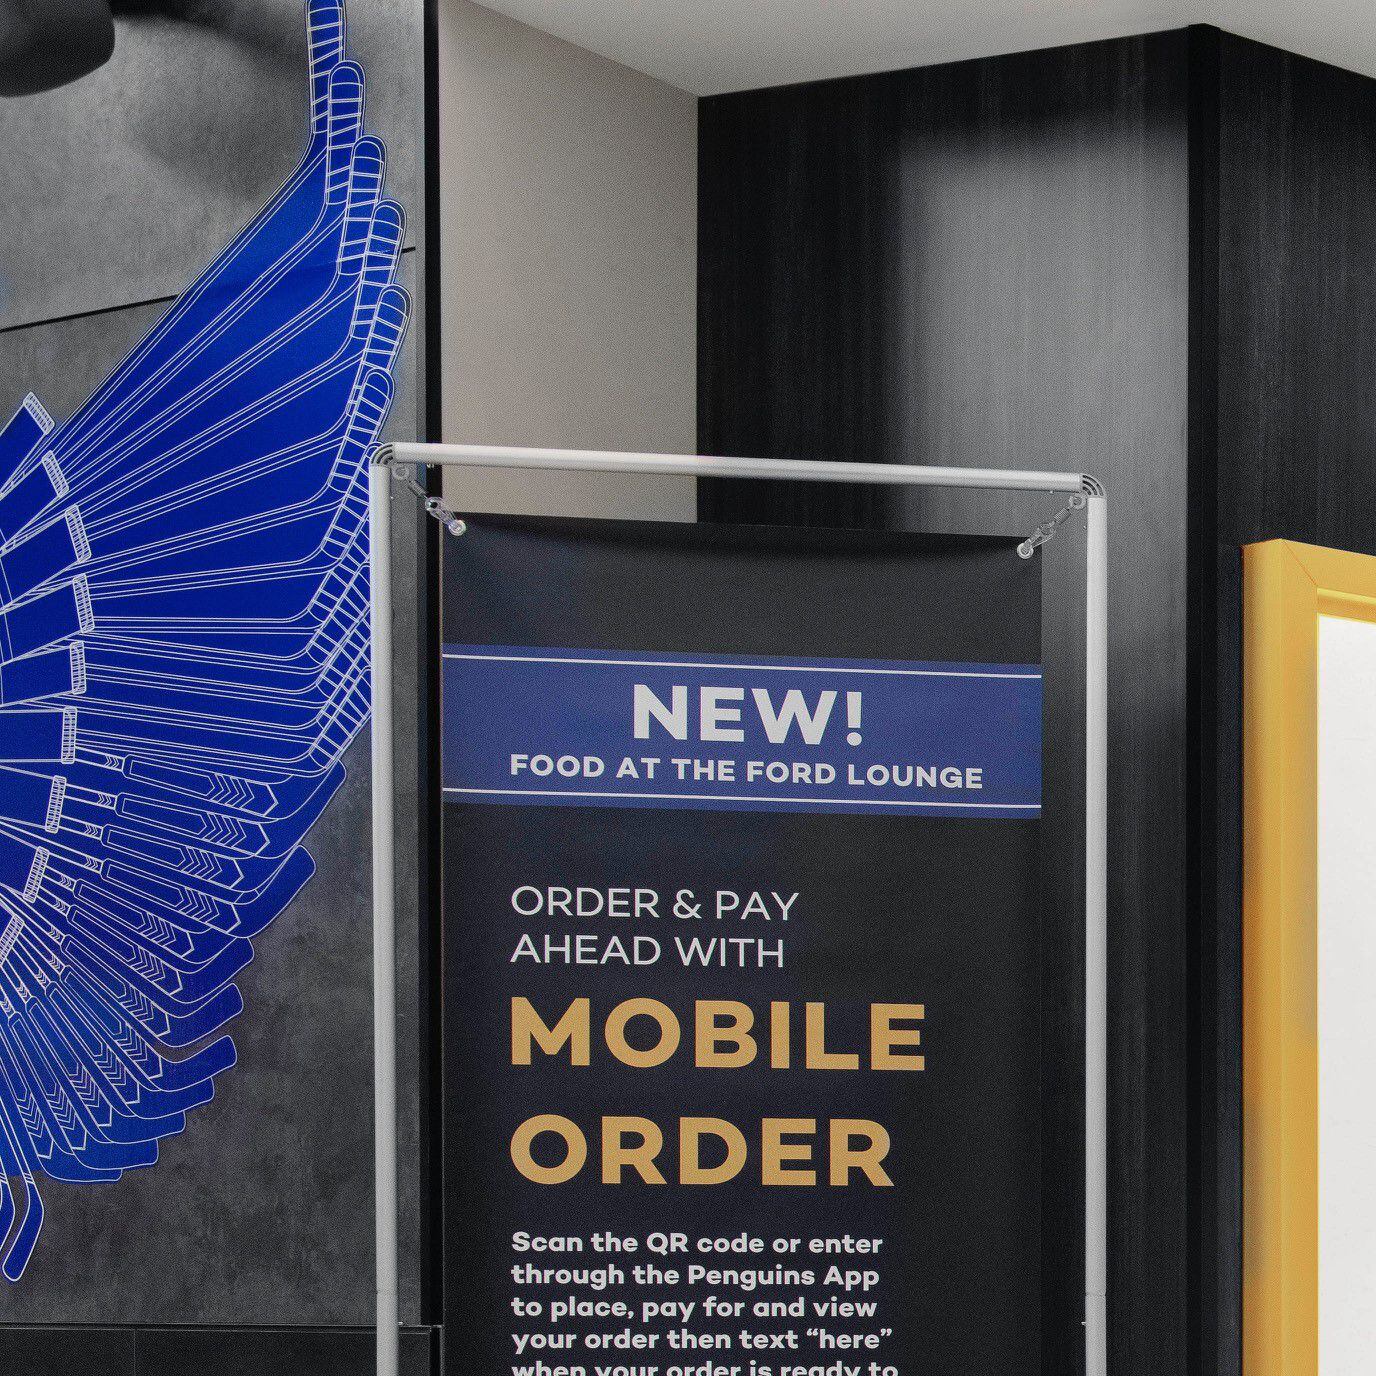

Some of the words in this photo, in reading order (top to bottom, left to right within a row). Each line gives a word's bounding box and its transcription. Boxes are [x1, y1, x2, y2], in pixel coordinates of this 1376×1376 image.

[633, 684, 863, 745] NEW!
[510, 754, 604, 779] FOOD
[617, 757, 660, 779] AT
[672, 758, 735, 782] THE
[747, 762, 836, 784] FORD
[848, 764, 983, 789] LOUNGE
[510, 886, 658, 918] ORDER
[672, 891, 701, 919] &
[716, 891, 799, 921] PAY
[510, 935, 660, 965] AHEAD
[674, 938, 784, 967] WITH
[511, 997, 925, 1071] MOBILE
[510, 1114, 894, 1187] ORDER
[512, 1232, 583, 1252] Scan
[591, 1233, 638, 1252] the
[647, 1233, 688, 1255] QR
[697, 1233, 764, 1253] code
[772, 1238, 801, 1253] or
[809, 1235, 882, 1253] enter
[511, 1264, 624, 1289] through
[633, 1265, 679, 1285] the
[689, 1265, 815, 1290] Penguins
[823, 1266, 879, 1290] App
[511, 1297, 542, 1316] to
[551, 1297, 635, 1321] place,
[643, 1302, 695, 1322] pay
[703, 1296, 745, 1317] for
[753, 1297, 804, 1317] and
[813, 1298, 877, 1317] view
[512, 1334, 576, 1353] your
[585, 1329, 659, 1349] order
[667, 1329, 731, 1349] then
[739, 1330, 798, 1349] text
